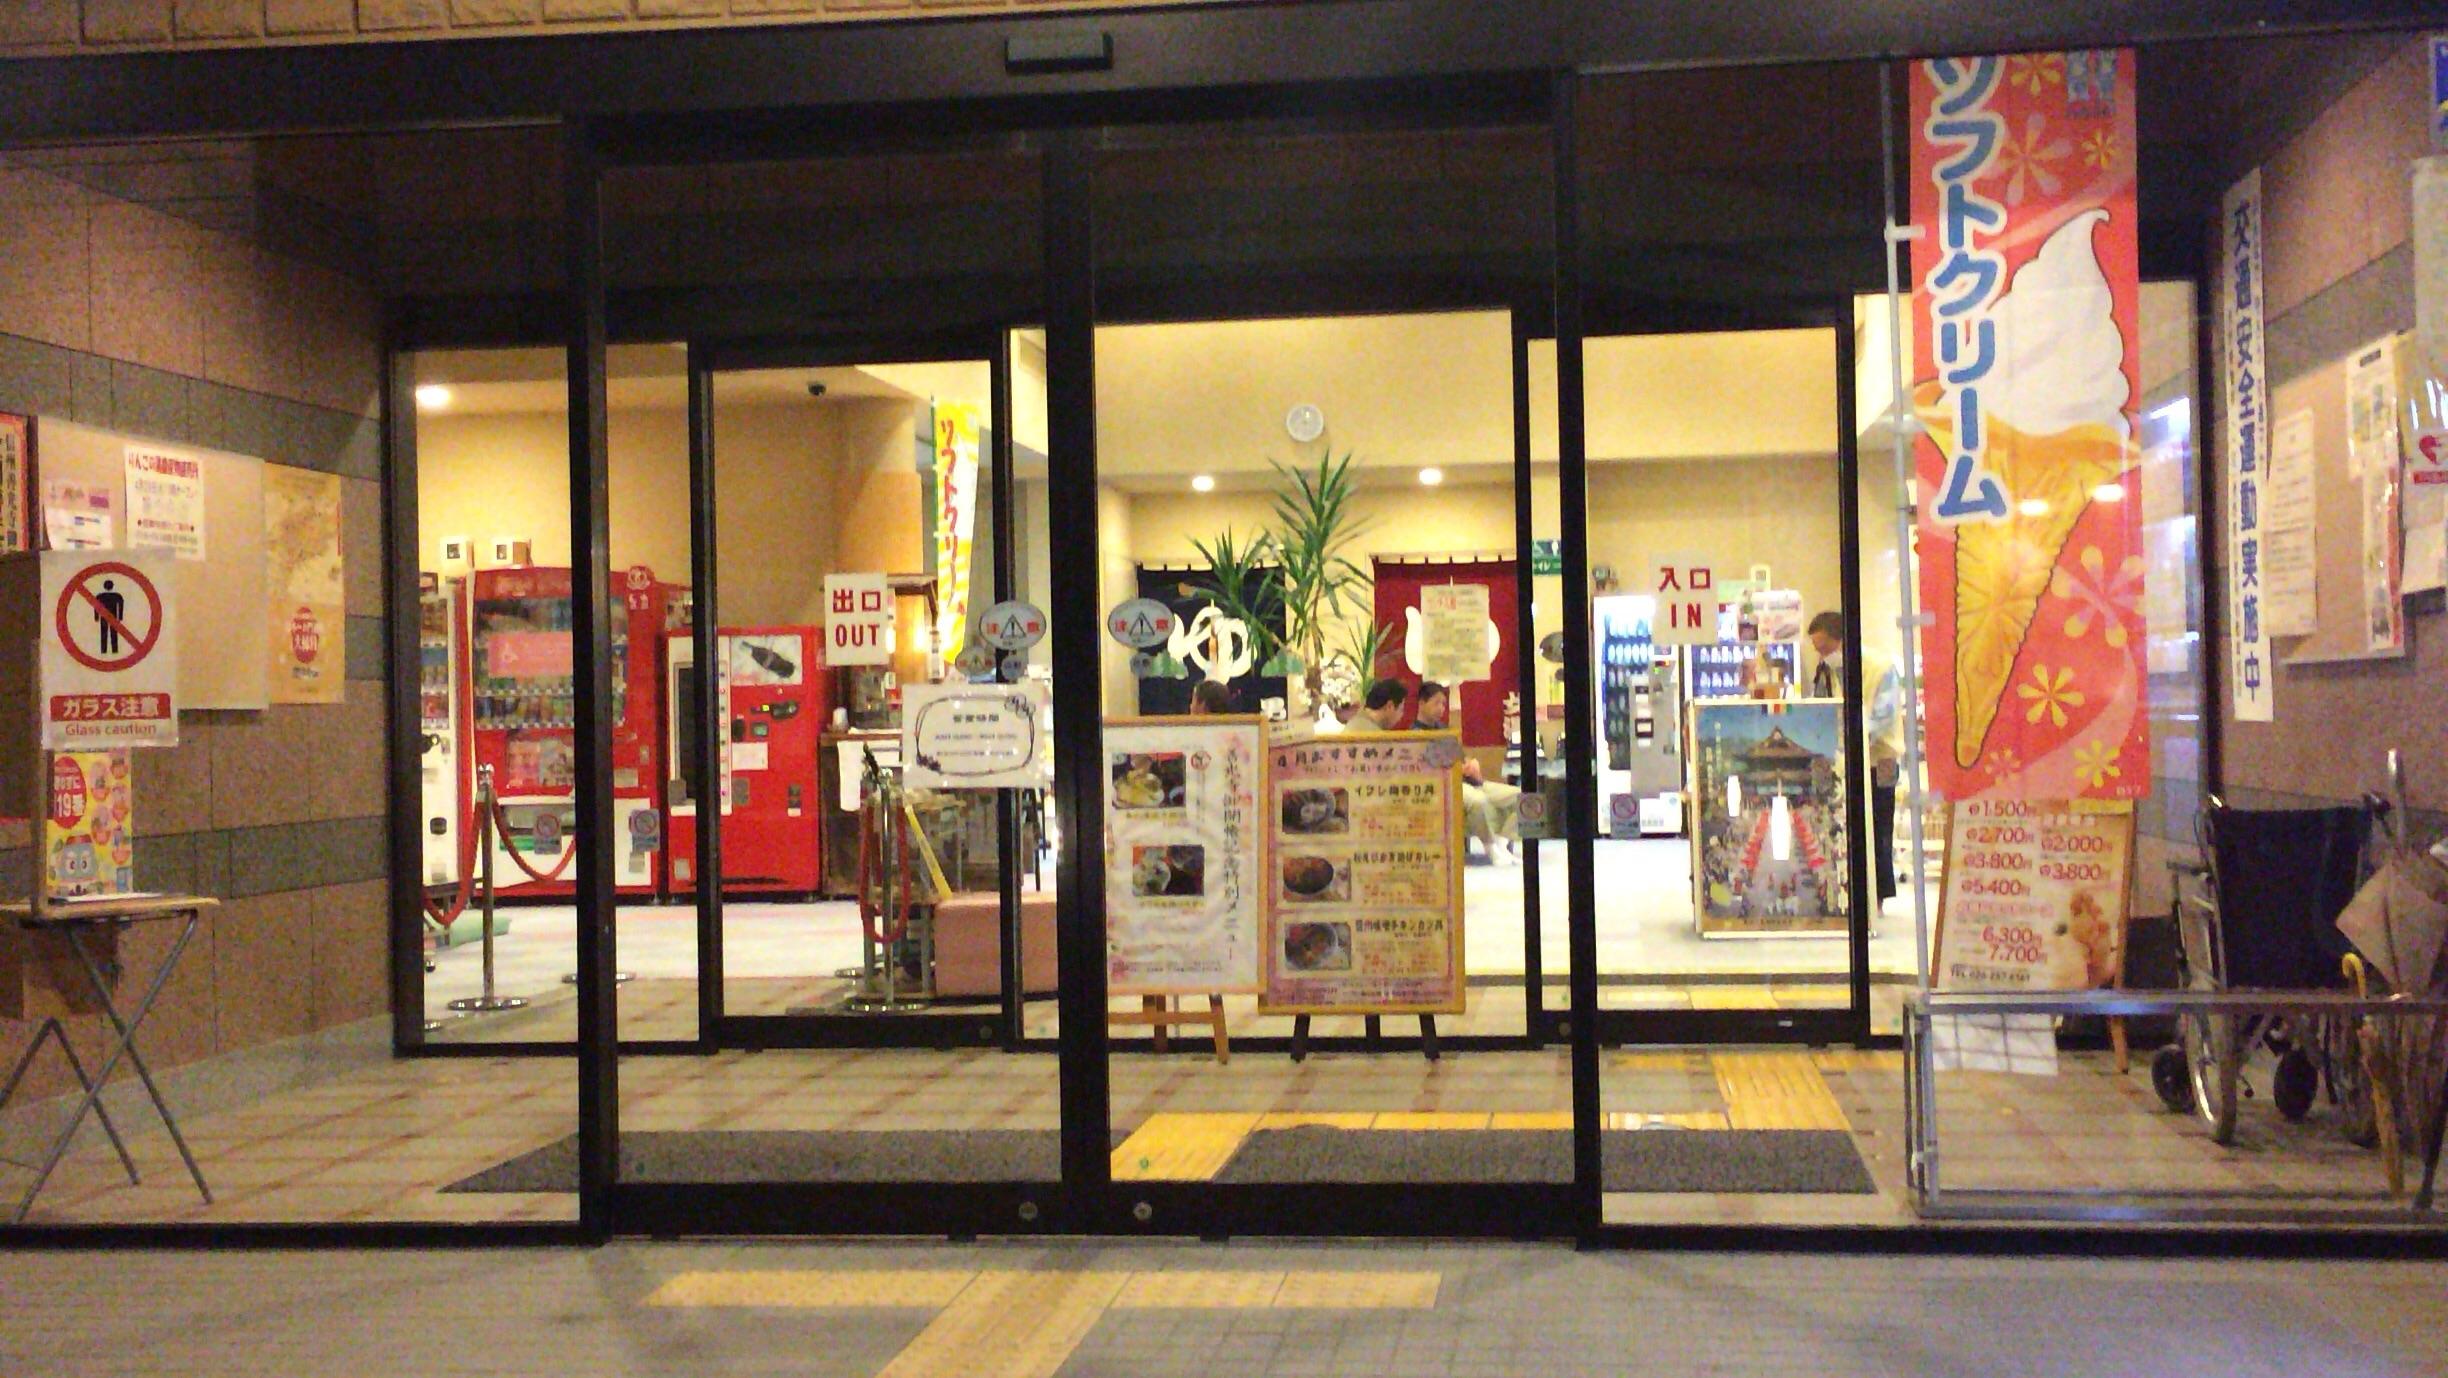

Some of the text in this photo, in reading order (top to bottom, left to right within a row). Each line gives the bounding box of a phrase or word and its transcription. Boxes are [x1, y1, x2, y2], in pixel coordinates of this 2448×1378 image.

[1926, 57, 2008, 521] ソフトクリーム
[941, 419, 965, 614] ソフトクリー
[1659, 567, 1711, 592] 入口
[833, 589, 881, 613] 出口
[1670, 604, 1703, 629] IN
[835, 624, 881, 648] OUT
[63, 698, 159, 718] ガラス注意
[65, 723, 157, 737] Glass caution
